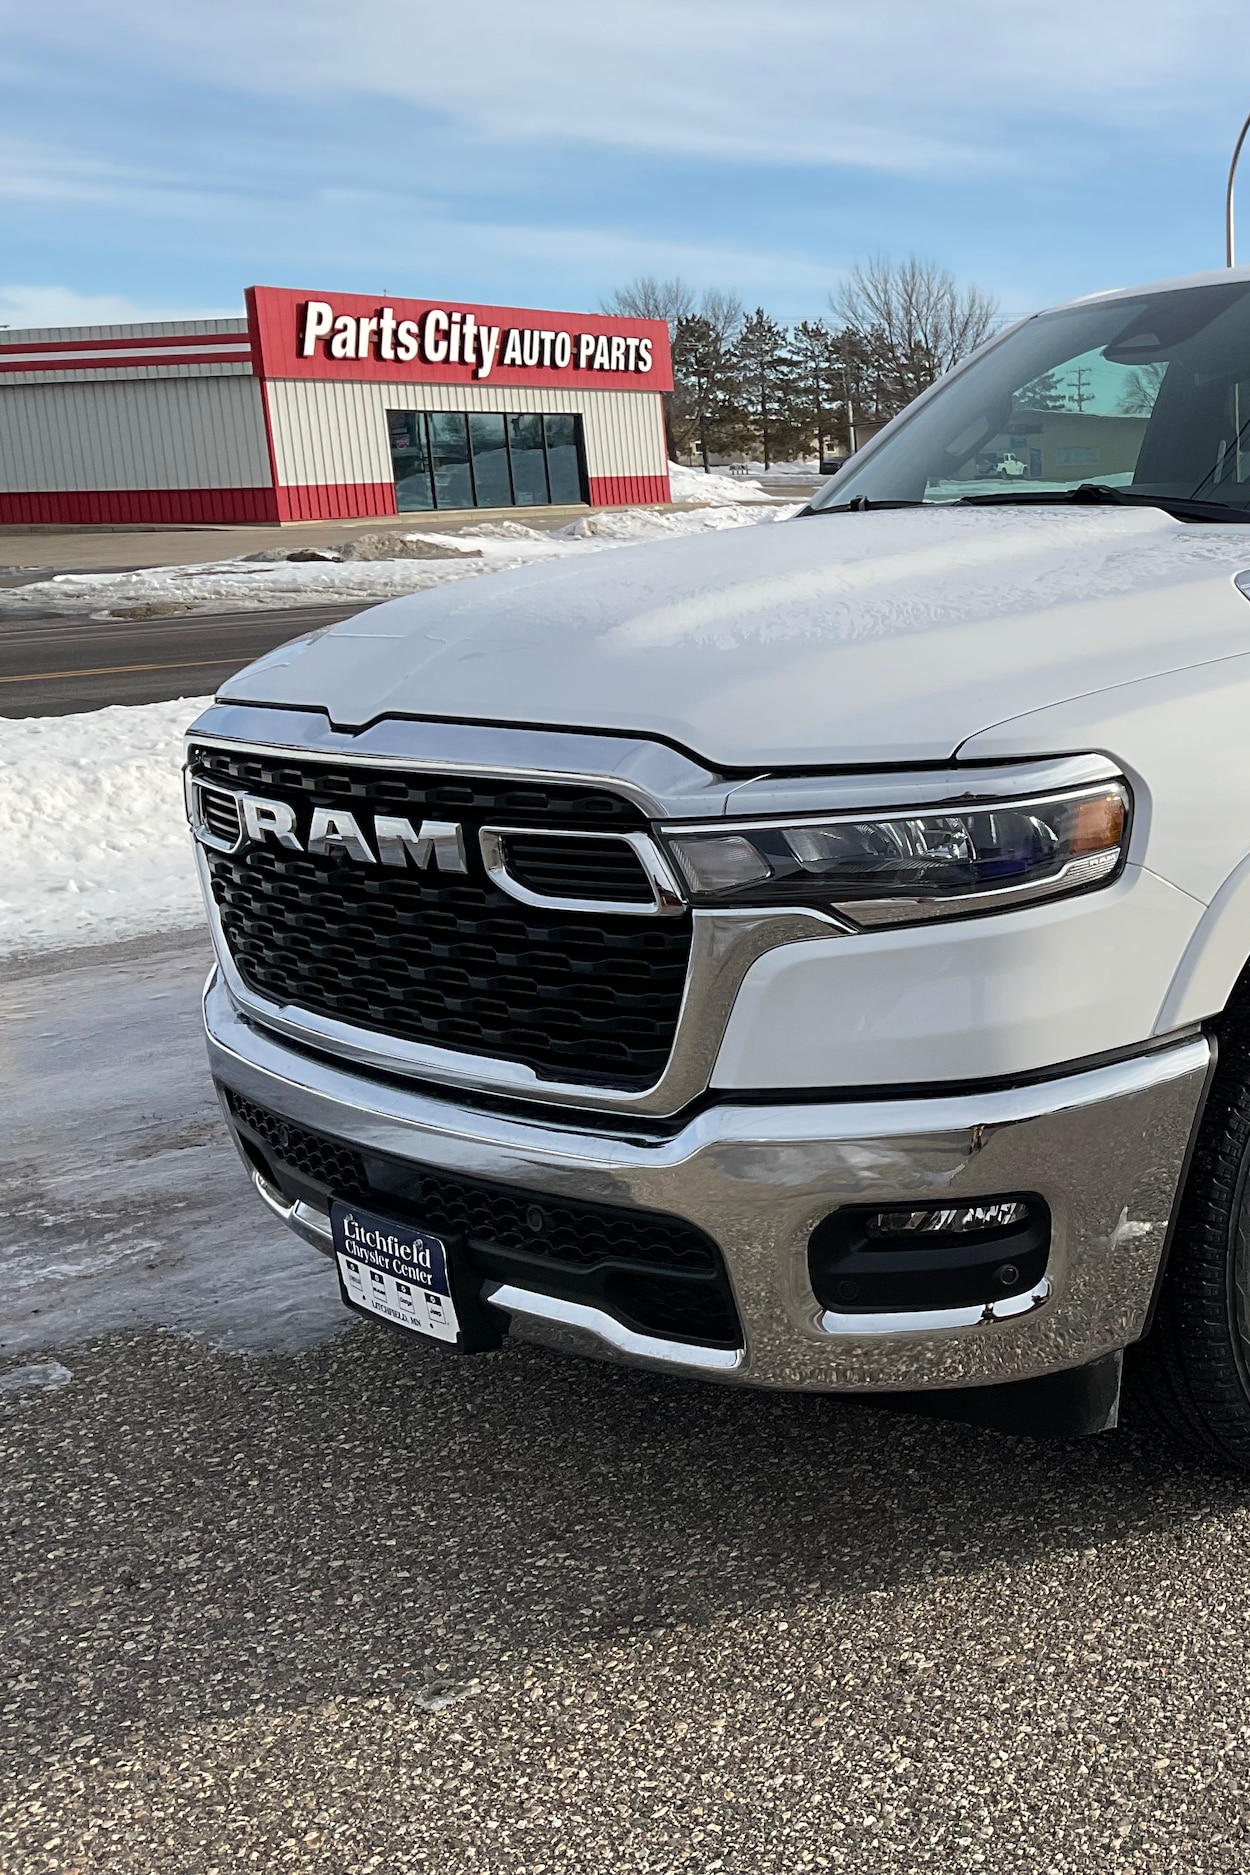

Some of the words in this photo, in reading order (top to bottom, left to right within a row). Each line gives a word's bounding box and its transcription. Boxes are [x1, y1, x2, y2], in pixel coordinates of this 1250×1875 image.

[503, 328, 571, 369] AUTO
[579, 333, 653, 373] PARTS
[241, 795, 468, 874] RAM
[1089, 854, 1116, 866] RAM
[343, 1217, 432, 1269] Litchfield
[345, 1239, 390, 1270] Chrysler
[392, 1259, 433, 1286] Center
